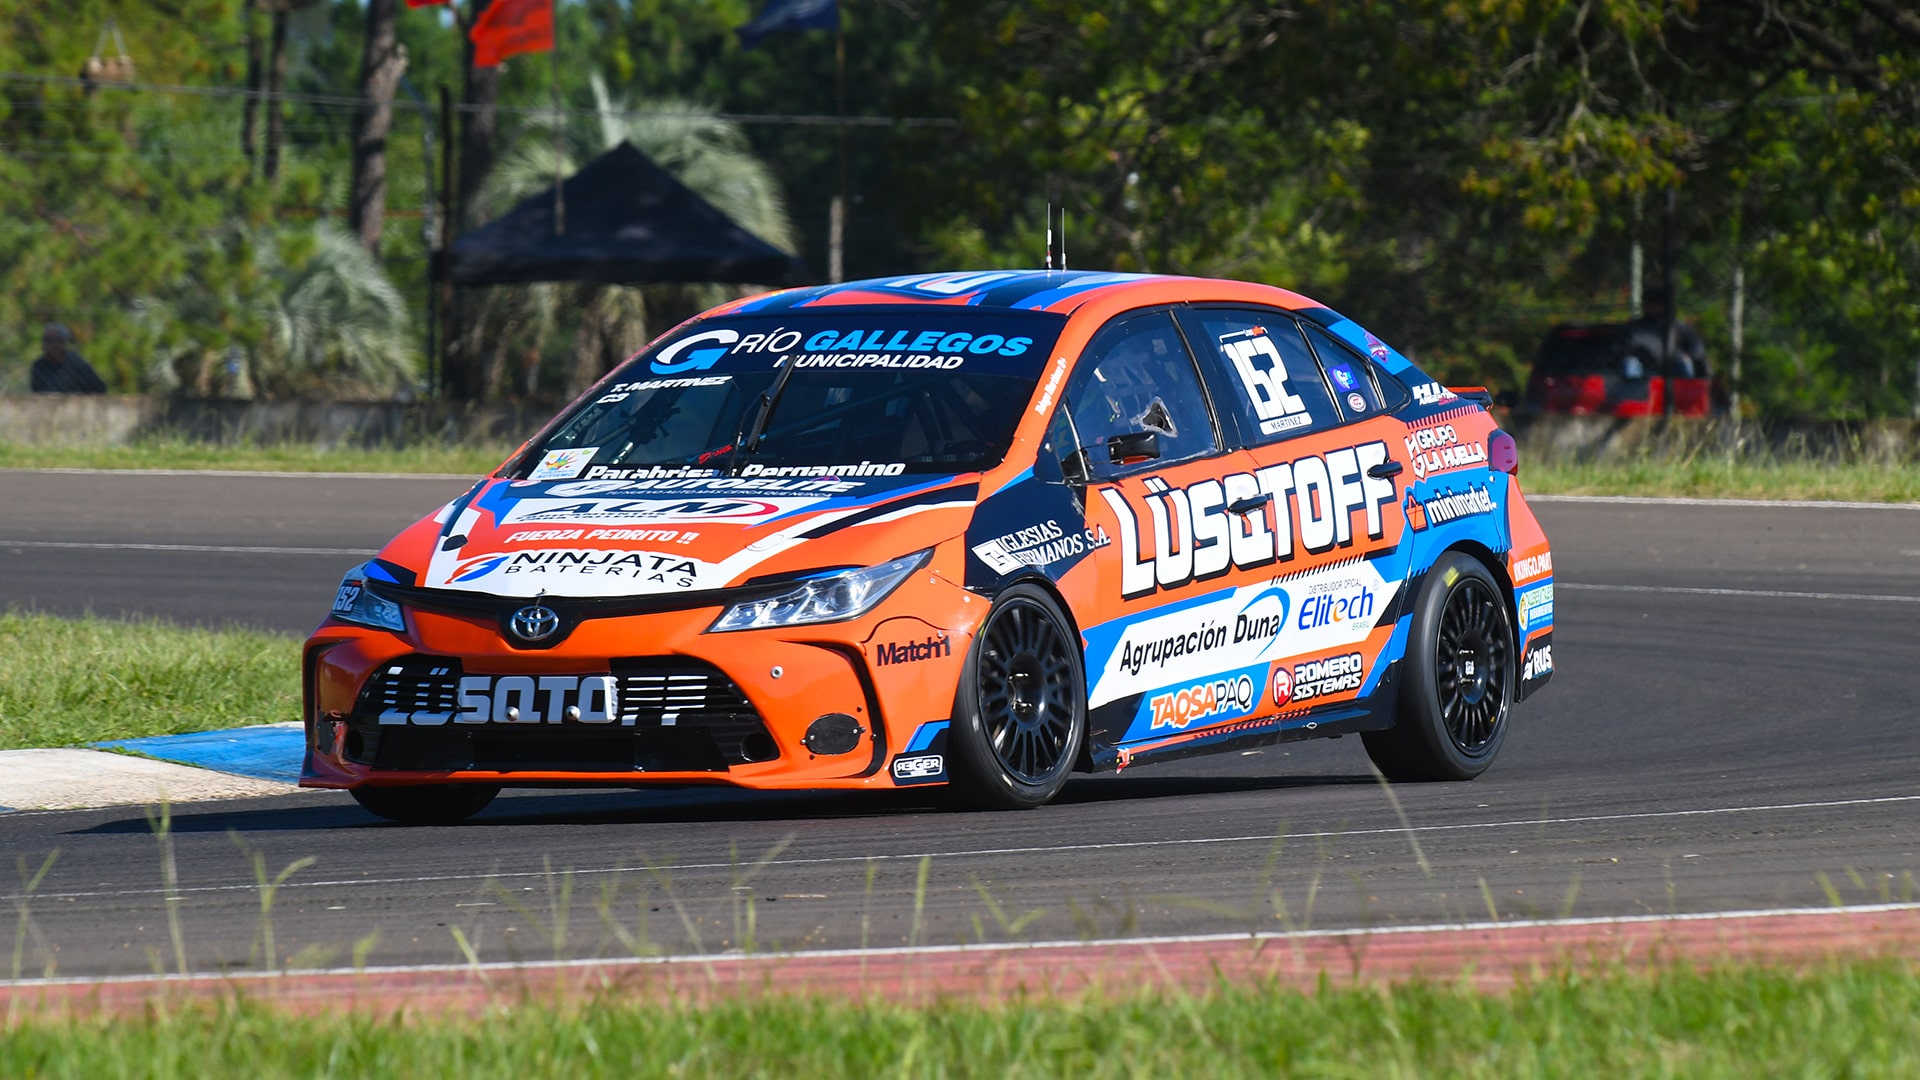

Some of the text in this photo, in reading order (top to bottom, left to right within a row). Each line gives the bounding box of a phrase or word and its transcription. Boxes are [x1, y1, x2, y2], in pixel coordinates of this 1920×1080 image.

[731, 327, 1033, 356] RÍO GALLEGOS
[773, 354, 964, 369] MUNICIPALIDAD
[625, 376, 733, 391] MARTINEZ
[1221, 336, 1306, 420] 152
[1271, 414, 1303, 430] MARTINEZ
[1416, 425, 1457, 450] GRUPO
[1424, 442, 1488, 474] LA HUELLA
[615, 478, 866, 493] AUTOELITE
[526, 501, 752, 517] ALM
[504, 529, 584, 544] FUERZA
[584, 529, 680, 543] PEDRITO
[994, 520, 1063, 552] IGLESIAS
[1011, 533, 1083, 565] HERMANOS
[504, 565, 694, 588] BATERIAS
[512, 551, 698, 578] NINJATA
[332, 586, 361, 612] 152
[1298, 586, 1374, 630] Elitech
[1120, 614, 1280, 676] Agrupación Duna
[1295, 654, 1362, 684] ROMERO
[1292, 672, 1362, 700] SISTEMAS
[1152, 676, 1252, 726] TAQSAPAQ
